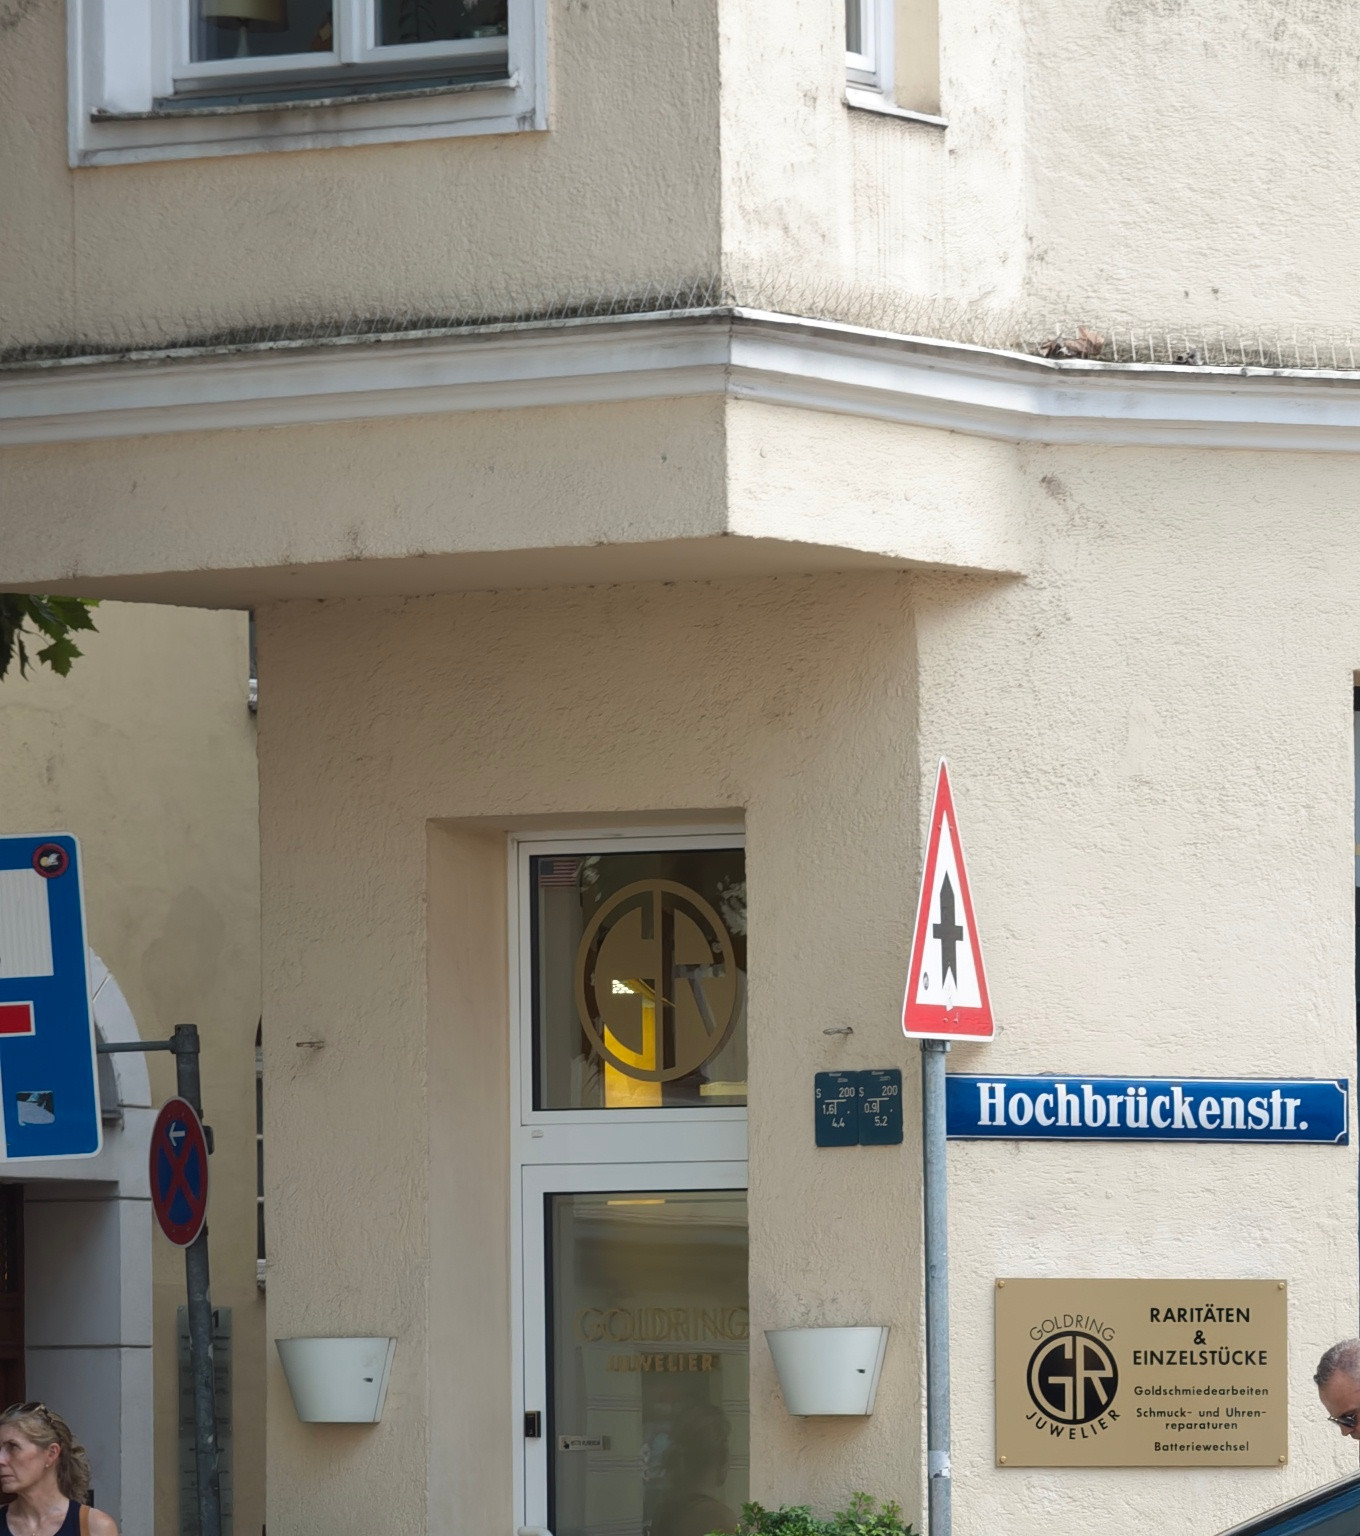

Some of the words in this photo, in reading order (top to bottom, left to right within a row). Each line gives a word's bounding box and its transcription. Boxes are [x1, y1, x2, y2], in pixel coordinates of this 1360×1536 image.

[816, 1088, 822, 1098] S
[838, 1087, 855, 1098] 200
[858, 1087, 865, 1097] S
[881, 1085, 899, 1096] 200
[976, 1082, 1308, 1131] Hochbrückenstr.
[1150, 1303, 1251, 1323] RARITÄTEN
[1028, 1313, 1116, 1341] GOLDRING
[1193, 1329, 1207, 1346] &
[1132, 1346, 1268, 1366] EINZELSTÜCKE
[1030, 1335, 1115, 1421] GR
[1133, 1386, 1269, 1397] Goldschmiedearbeiten
[1136, 1407, 1193, 1418] Schmuck-
[1198, 1407, 1220, 1418] und
[1225, 1407, 1267, 1418] Uhren-
[1025, 1408, 1121, 1440] JUWELIER
[1165, 1420, 1238, 1434] reparaturen
[1154, 1441, 1250, 1452] Batteriewechsel
